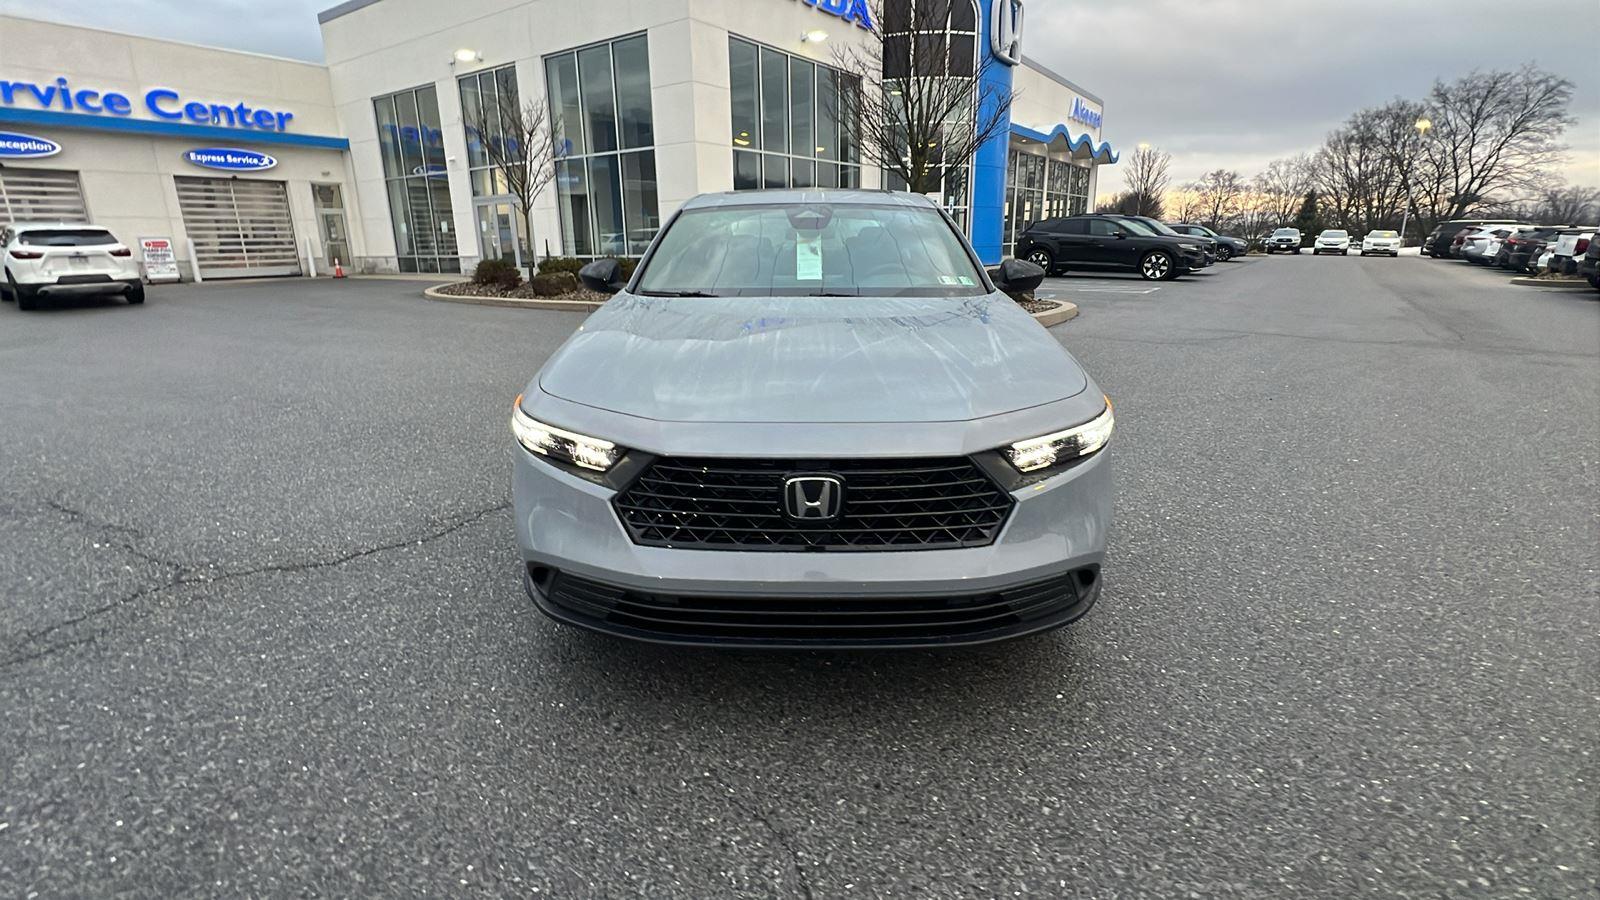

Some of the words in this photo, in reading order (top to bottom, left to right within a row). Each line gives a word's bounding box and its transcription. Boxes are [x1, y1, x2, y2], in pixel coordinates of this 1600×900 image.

[0, 77, 132, 115] rvice
[145, 89, 293, 131] Center
[189, 152, 225, 164] Express
[226, 154, 259, 165] Service
